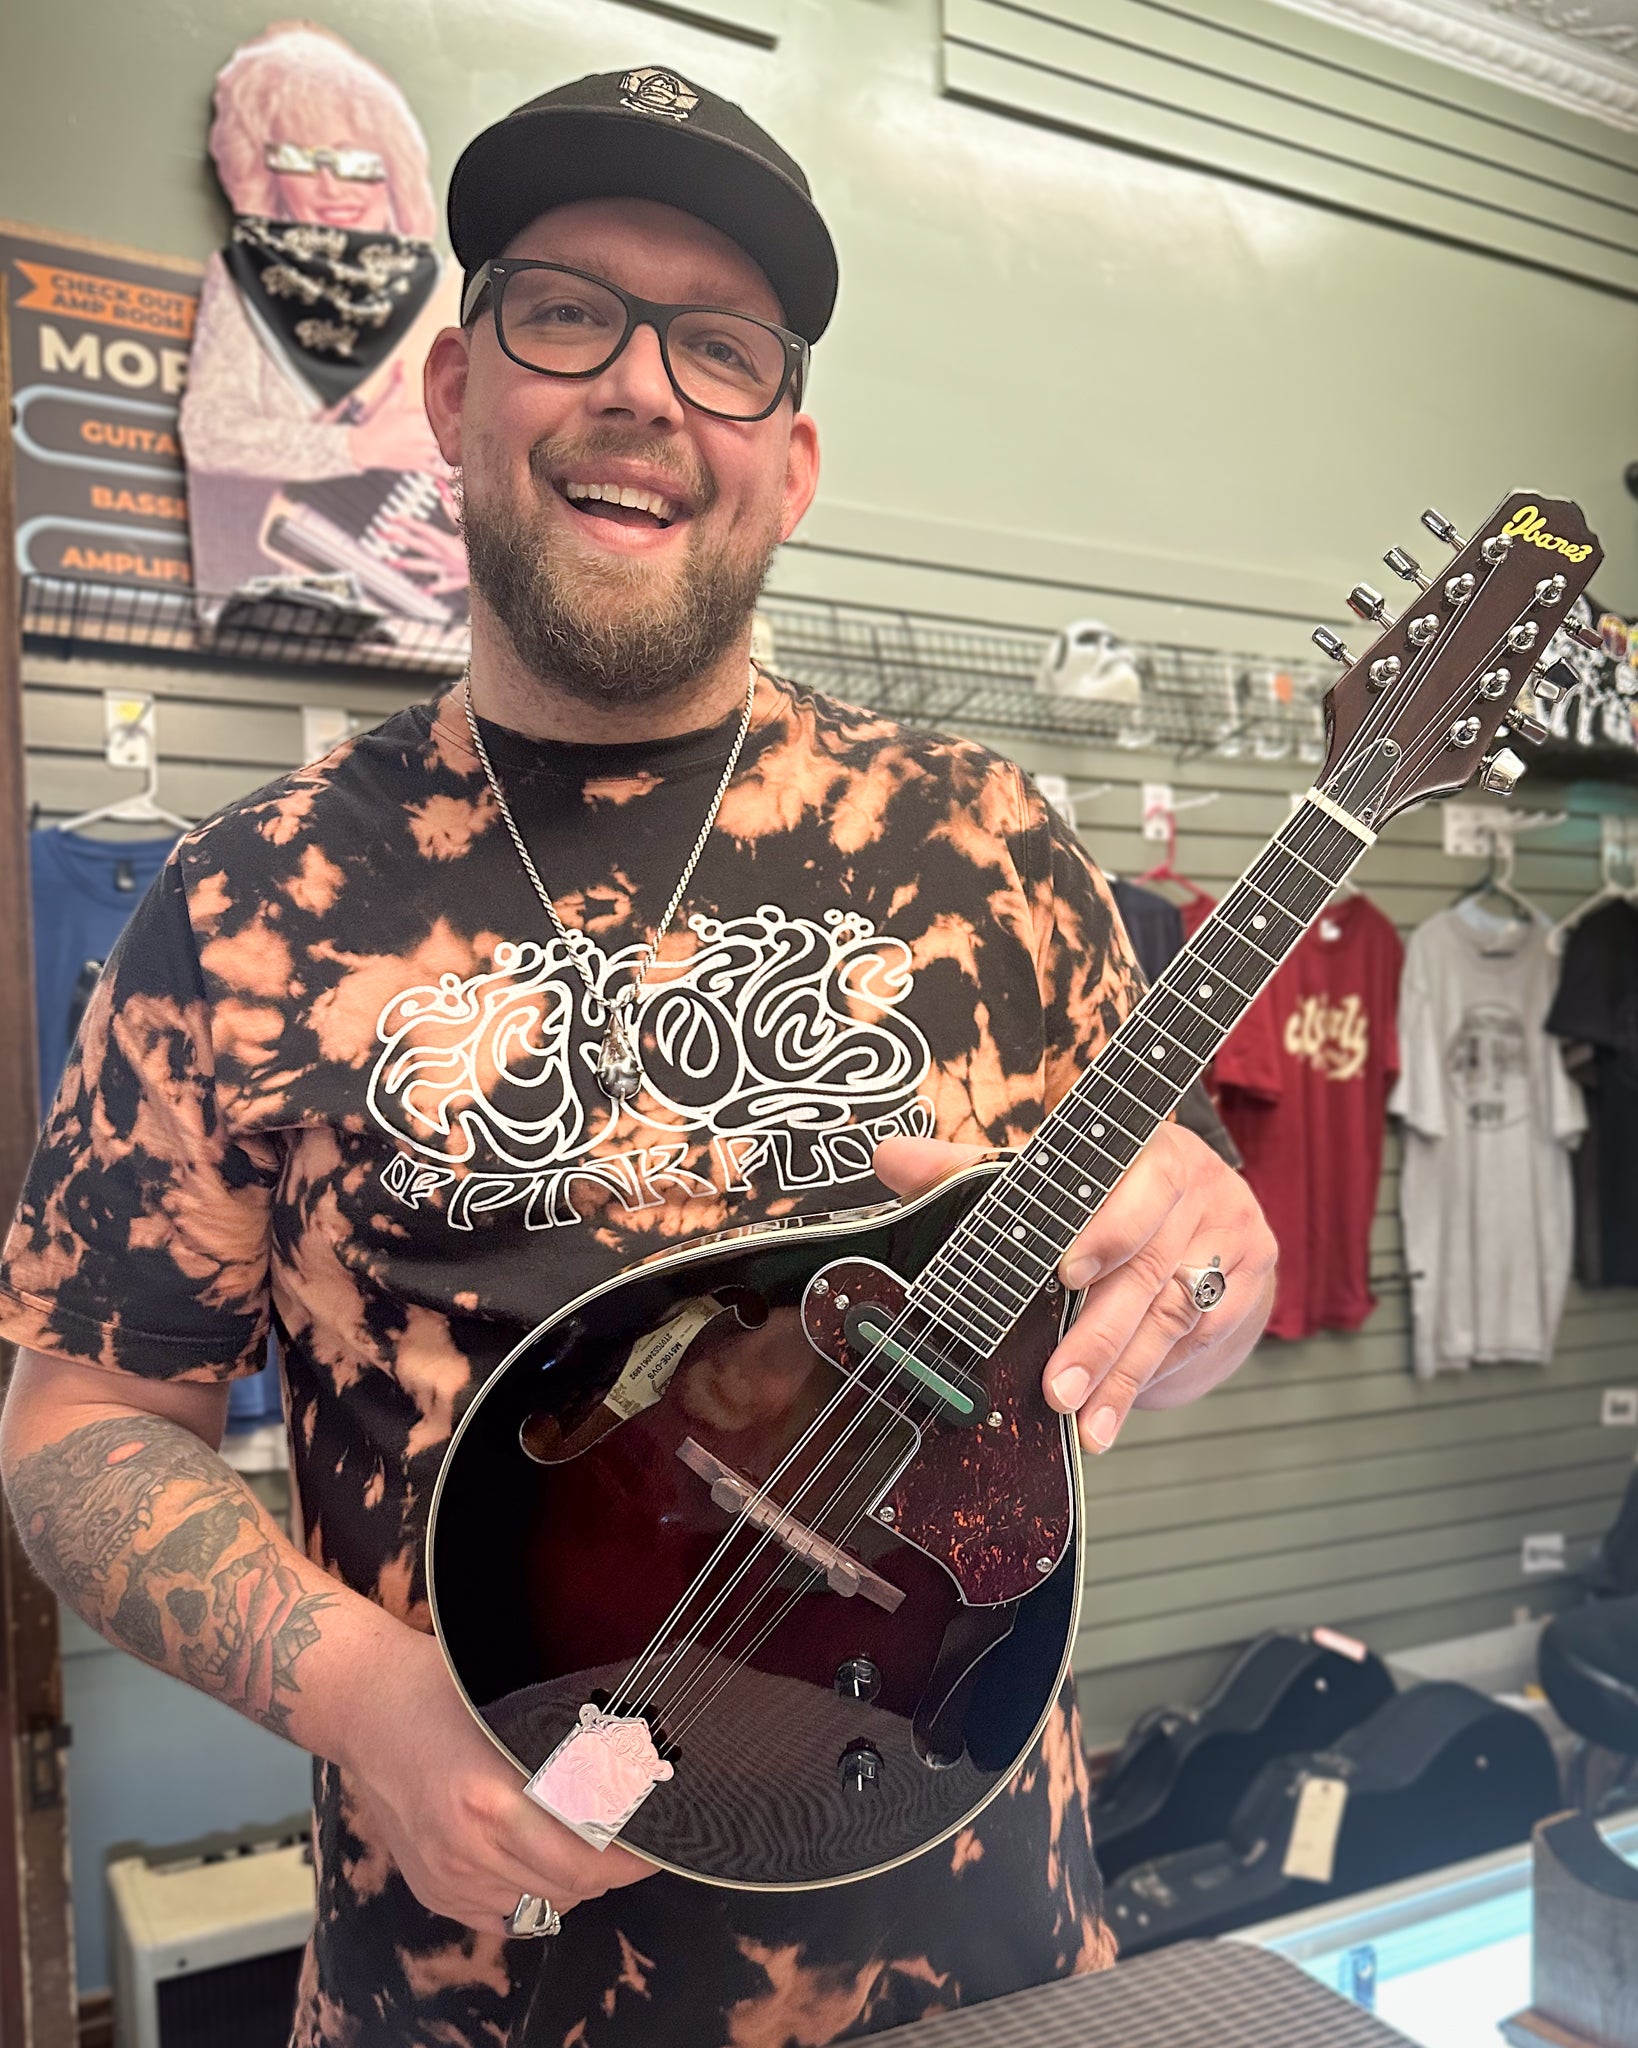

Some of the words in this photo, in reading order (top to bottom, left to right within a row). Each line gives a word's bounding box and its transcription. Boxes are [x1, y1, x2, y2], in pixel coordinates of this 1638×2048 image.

[51, 274, 131, 302] CHECK
[138, 293, 183, 312] OUT
[1502, 505, 1593, 563] Ibanez
[447, 1143, 715, 1232] PINK
